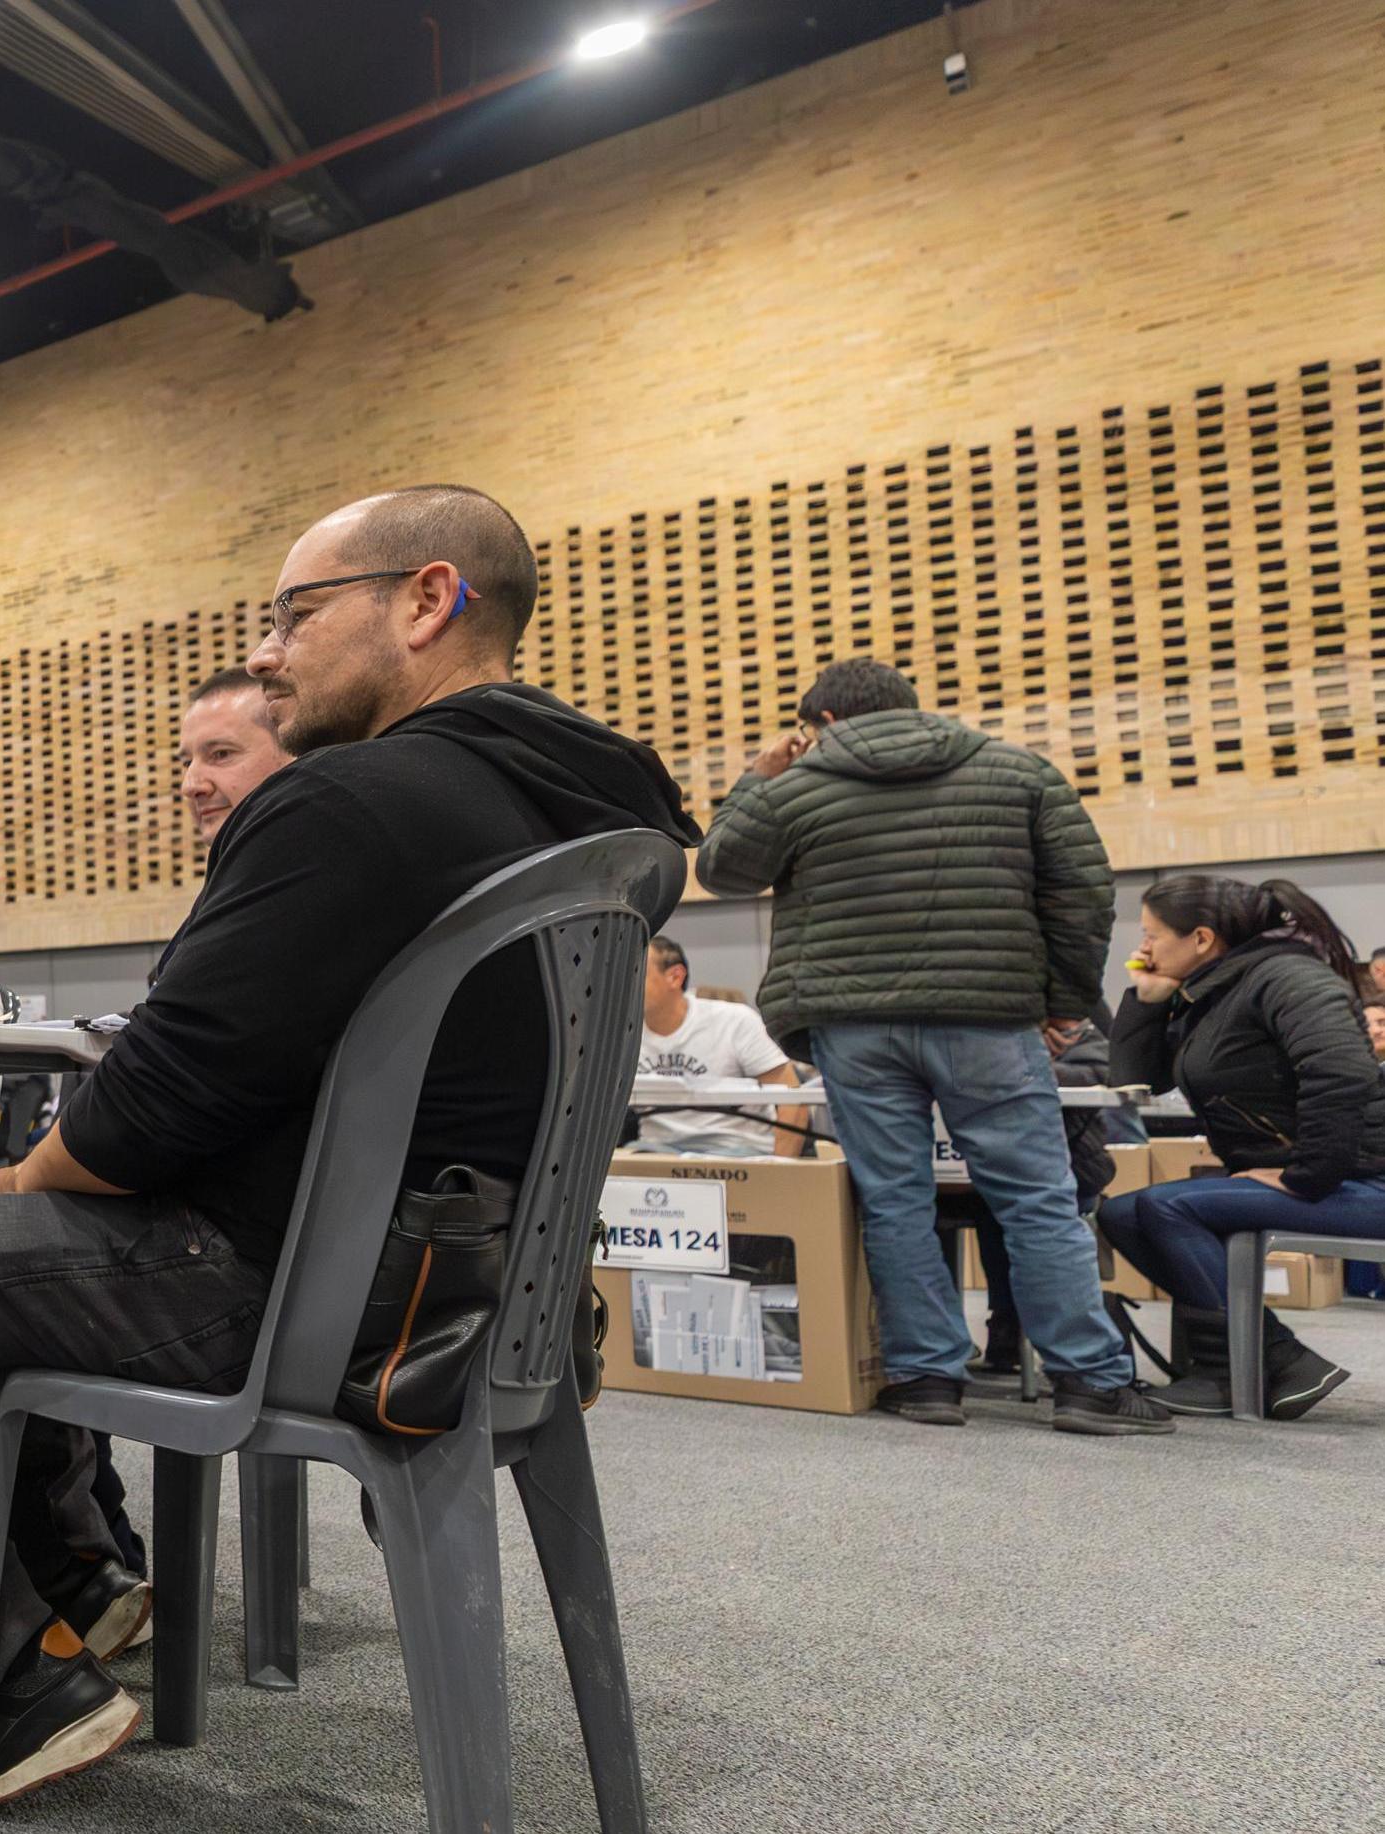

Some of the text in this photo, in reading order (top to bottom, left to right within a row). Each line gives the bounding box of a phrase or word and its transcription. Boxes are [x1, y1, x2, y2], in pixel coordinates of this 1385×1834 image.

[671, 1167, 749, 1182] SENADO
[605, 1226, 721, 1253] MESA 124
